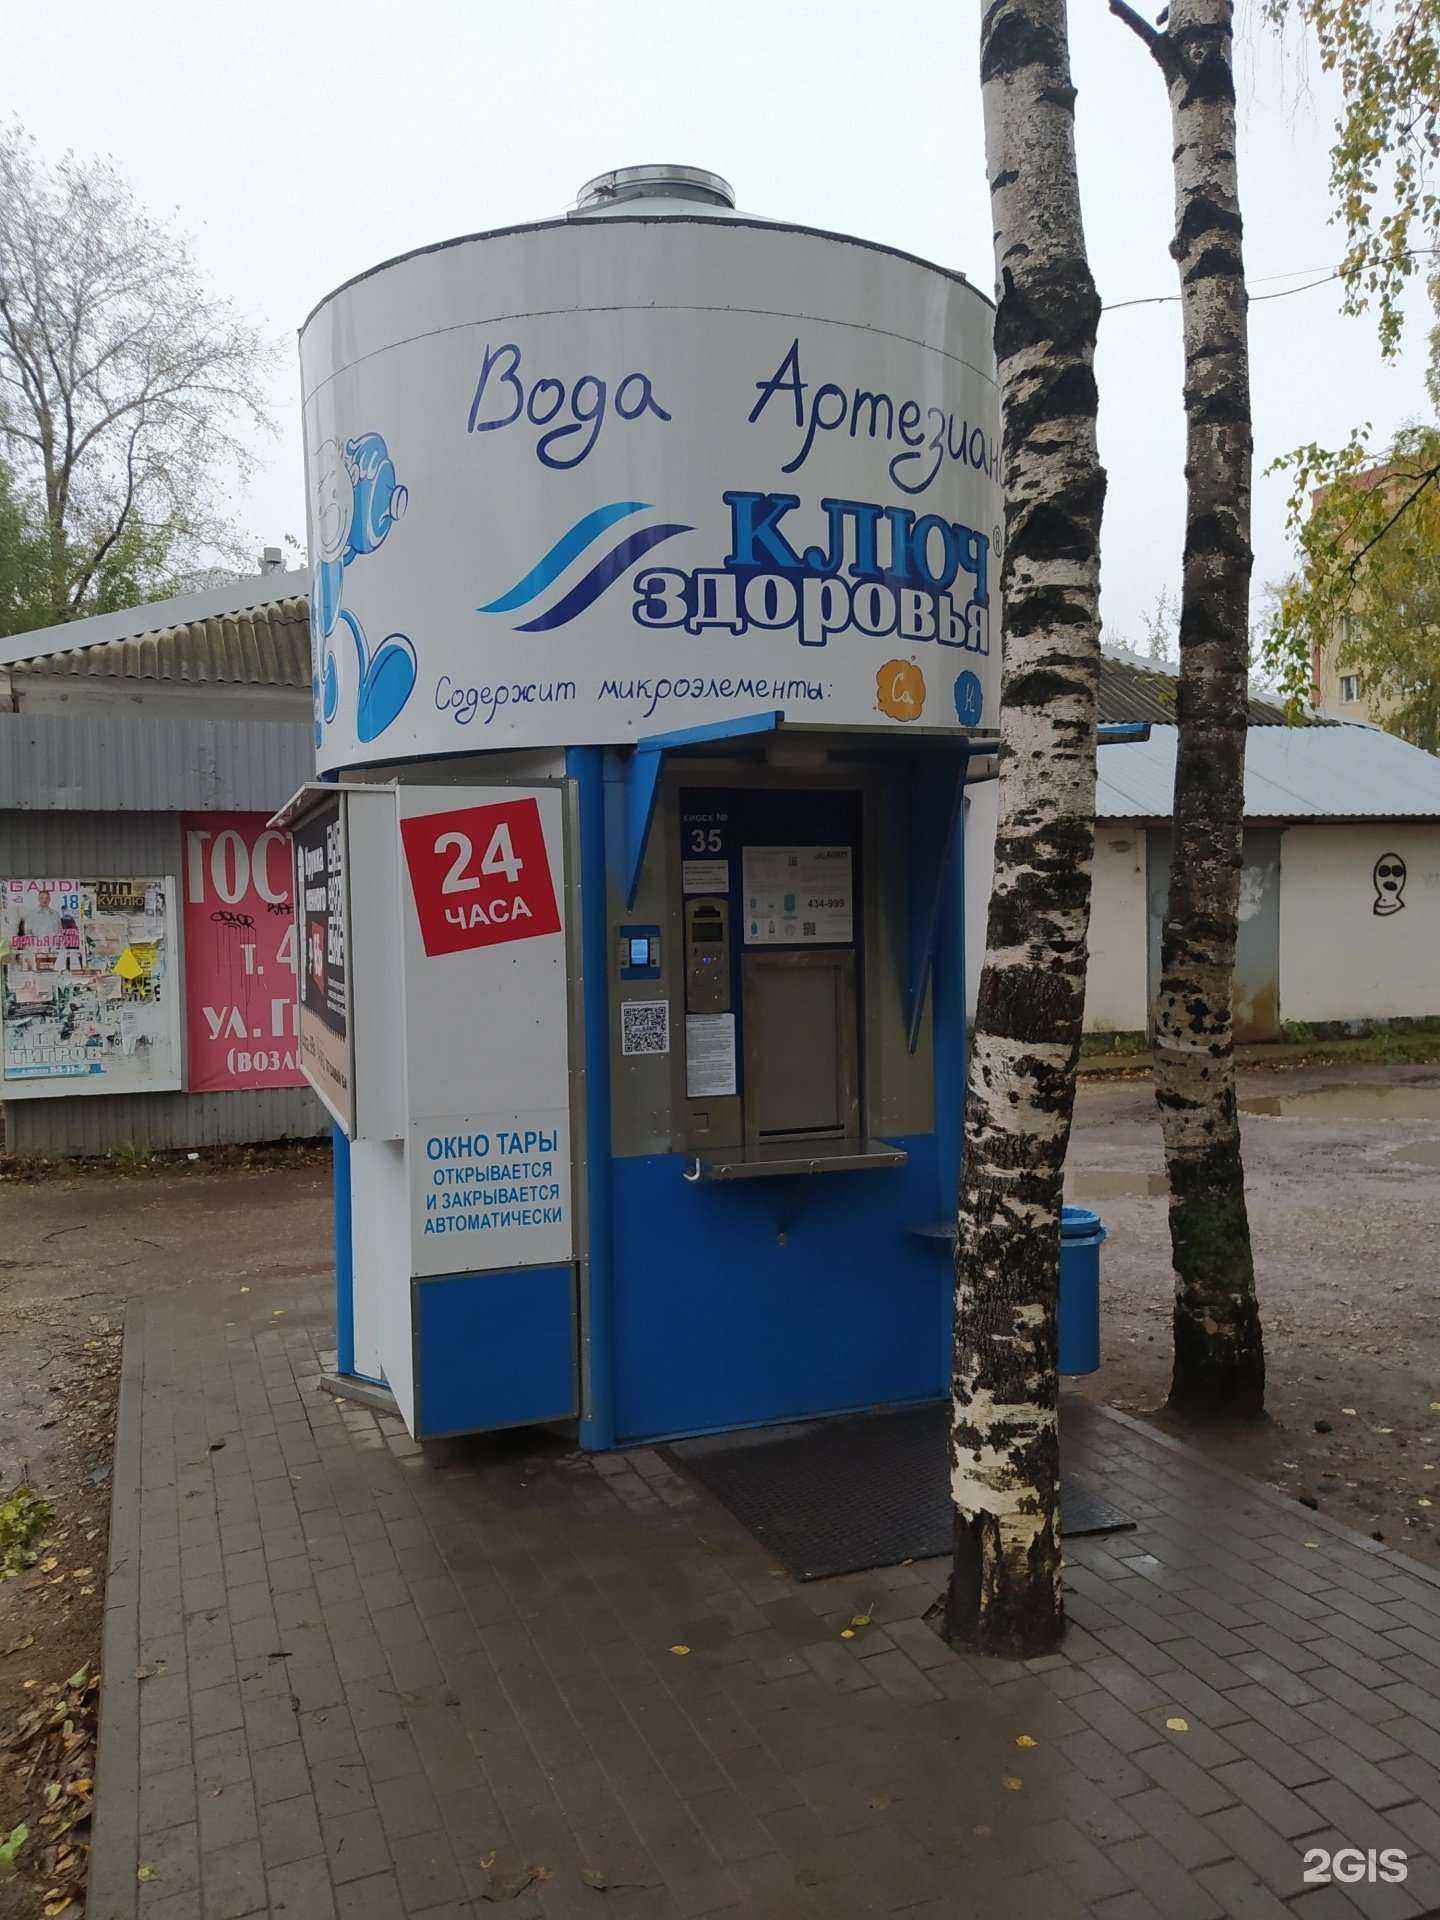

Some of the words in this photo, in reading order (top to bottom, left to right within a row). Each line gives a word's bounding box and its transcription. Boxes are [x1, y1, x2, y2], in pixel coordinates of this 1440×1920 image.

[467, 343, 672, 470] Вода
[434, 674, 577, 726] Содержит
[598, 672, 833, 718] микроэлементы:
[691, 828, 722, 853] 35
[187, 830, 294, 904] ГОС
[434, 822, 524, 895] 24
[444, 895, 533, 930] ЧАСА
[426, 1134, 490, 1161] ОКНО
[496, 1130, 558, 1155] ТАРЫ
[433, 1161, 552, 1186] ОТКРЫВАЕТСЯ
[426, 1194, 437, 1211] И
[442, 1184, 560, 1209] ЗАКРЫВАЕТСЯ
[424, 1207, 563, 1235] АВТОМАТИЧЕСКИ
